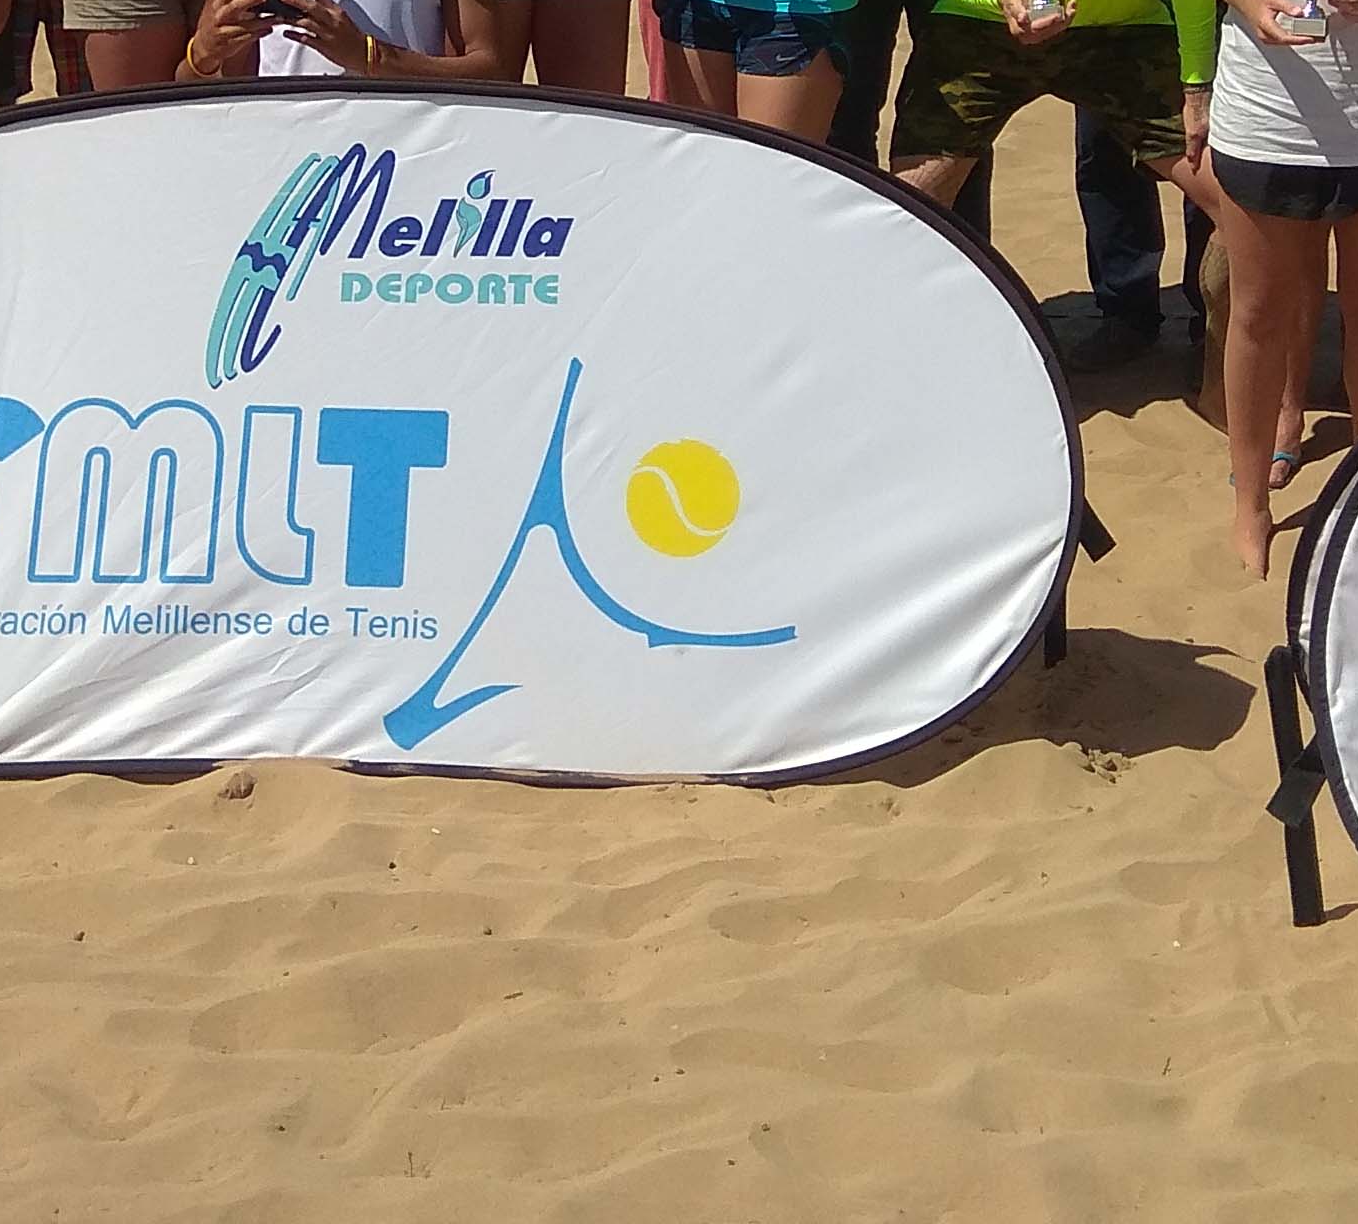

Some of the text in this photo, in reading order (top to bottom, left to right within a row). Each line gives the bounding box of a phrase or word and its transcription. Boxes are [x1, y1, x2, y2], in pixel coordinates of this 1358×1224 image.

[317, 142, 575, 260] Melilla
[340, 272, 559, 305] DEPORTE
[102, 605, 273, 636] Melillense
[287, 605, 330, 636] de
[344, 607, 439, 640] Tenis
